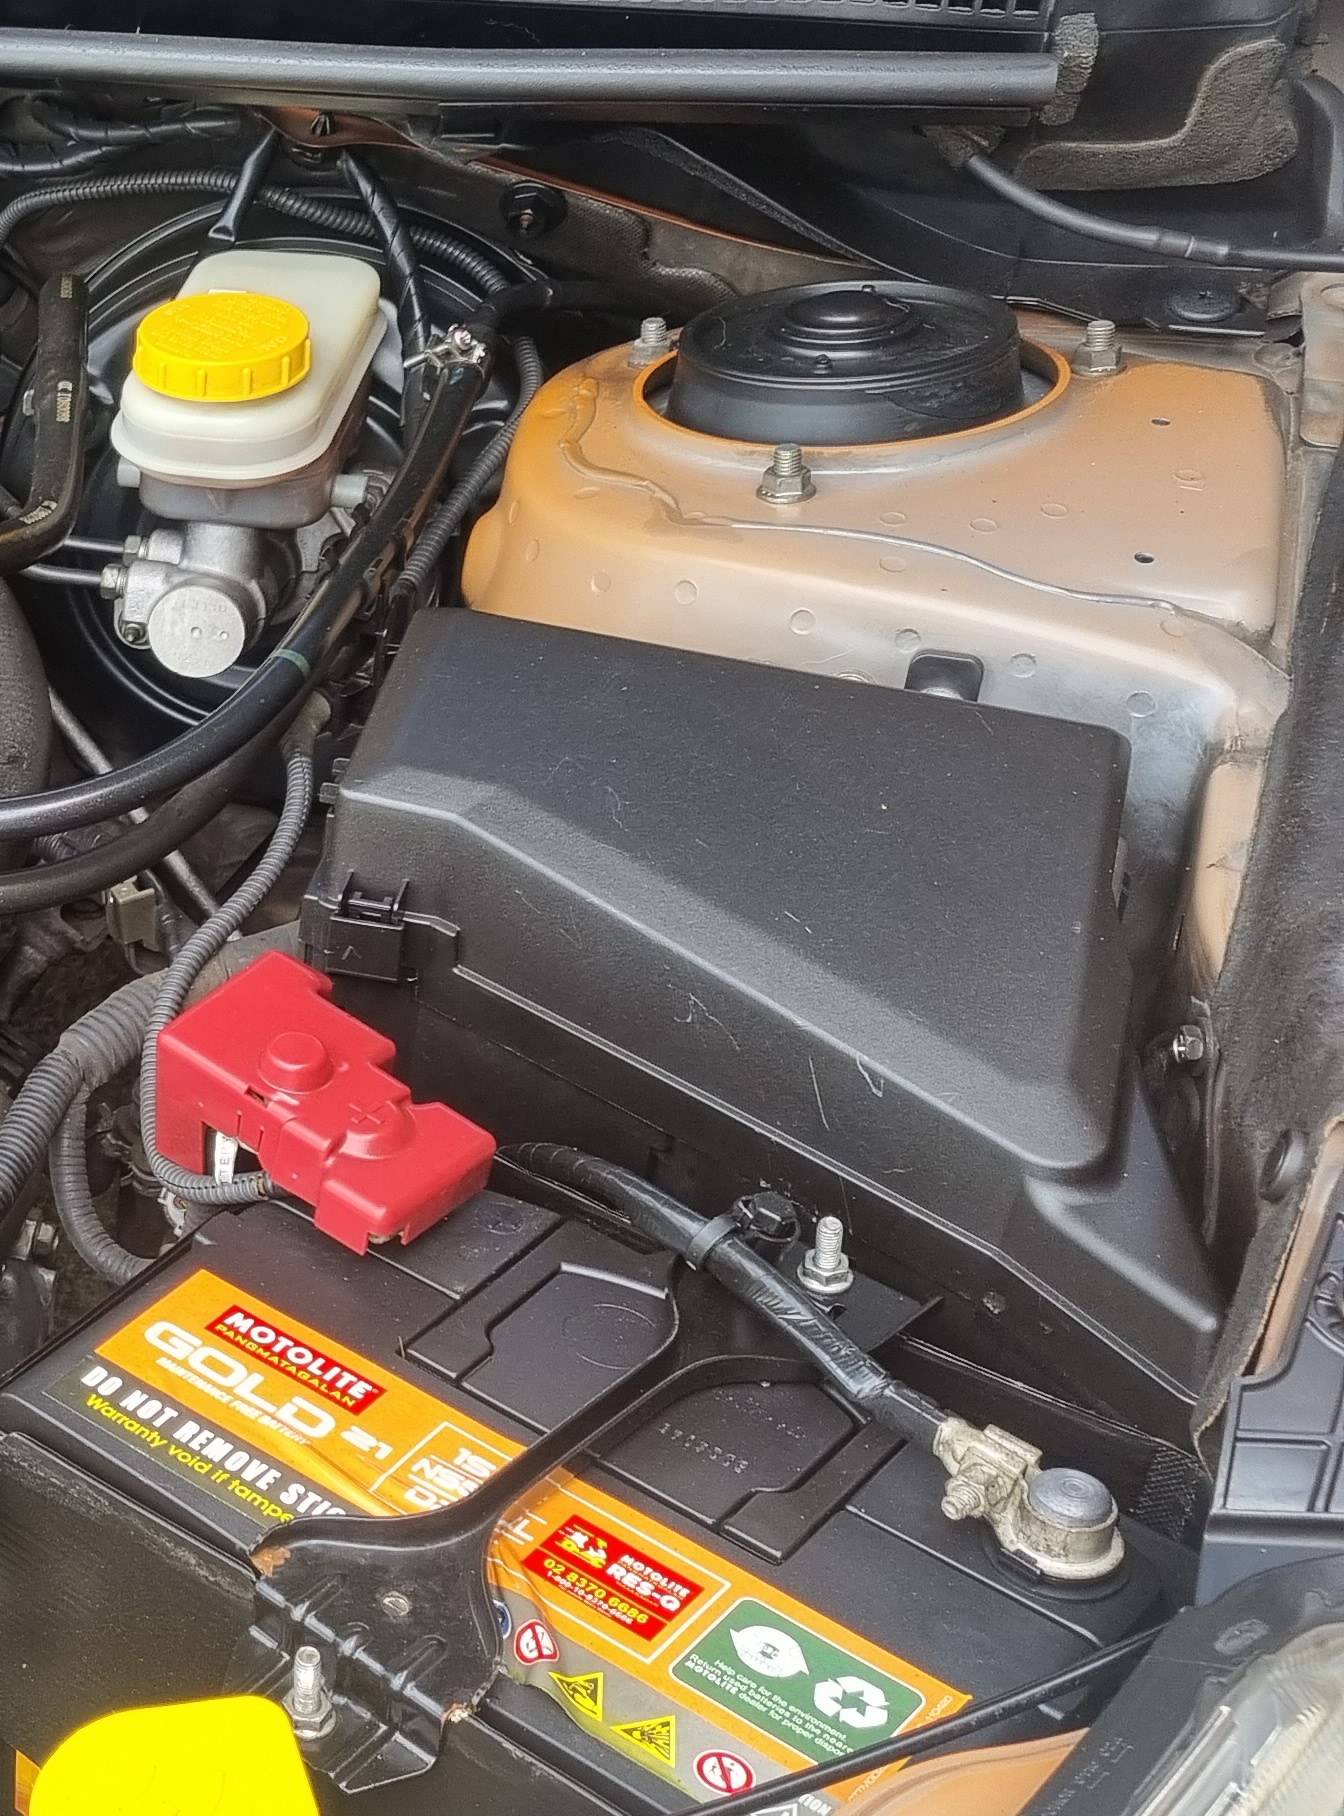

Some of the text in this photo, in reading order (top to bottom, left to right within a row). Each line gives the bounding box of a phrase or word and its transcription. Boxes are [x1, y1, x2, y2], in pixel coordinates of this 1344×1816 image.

[143, 1320, 394, 1461] GOLD 21
[214, 1323, 356, 1407] PANGMATAGALAN
[223, 1311, 375, 1400] MOTOLITE
[80, 1365, 124, 1397] DO
[118, 1382, 179, 1428] NOT
[172, 1419, 283, 1492] REMOVE
[85, 1392, 169, 1450] Warranty
[167, 1443, 214, 1475] void
[210, 1469, 231, 1484] if
[543, 1557, 566, 1575] 02
[566, 1569, 608, 1600] 8370
[608, 1597, 650, 1625] 6686
[605, 1562, 682, 1613] RES-Q
[619, 1553, 691, 1598] MOTOLITE
[684, 1659, 739, 1695] MOTOLITE
[738, 1692, 768, 1713] dealer
[768, 1709, 783, 1721] for
[781, 1719, 814, 1740] proper
[689, 1653, 722, 1677] Return
[722, 1674, 748, 1692] used
[748, 1688, 791, 1718] batteries
[792, 1715, 803, 1725] to
[804, 1722, 822, 1735] the
[714, 1659, 736, 1676] Help
[736, 1673, 758, 1689] care
[757, 1685, 772, 1697] for
[771, 1694, 788, 1708] the
